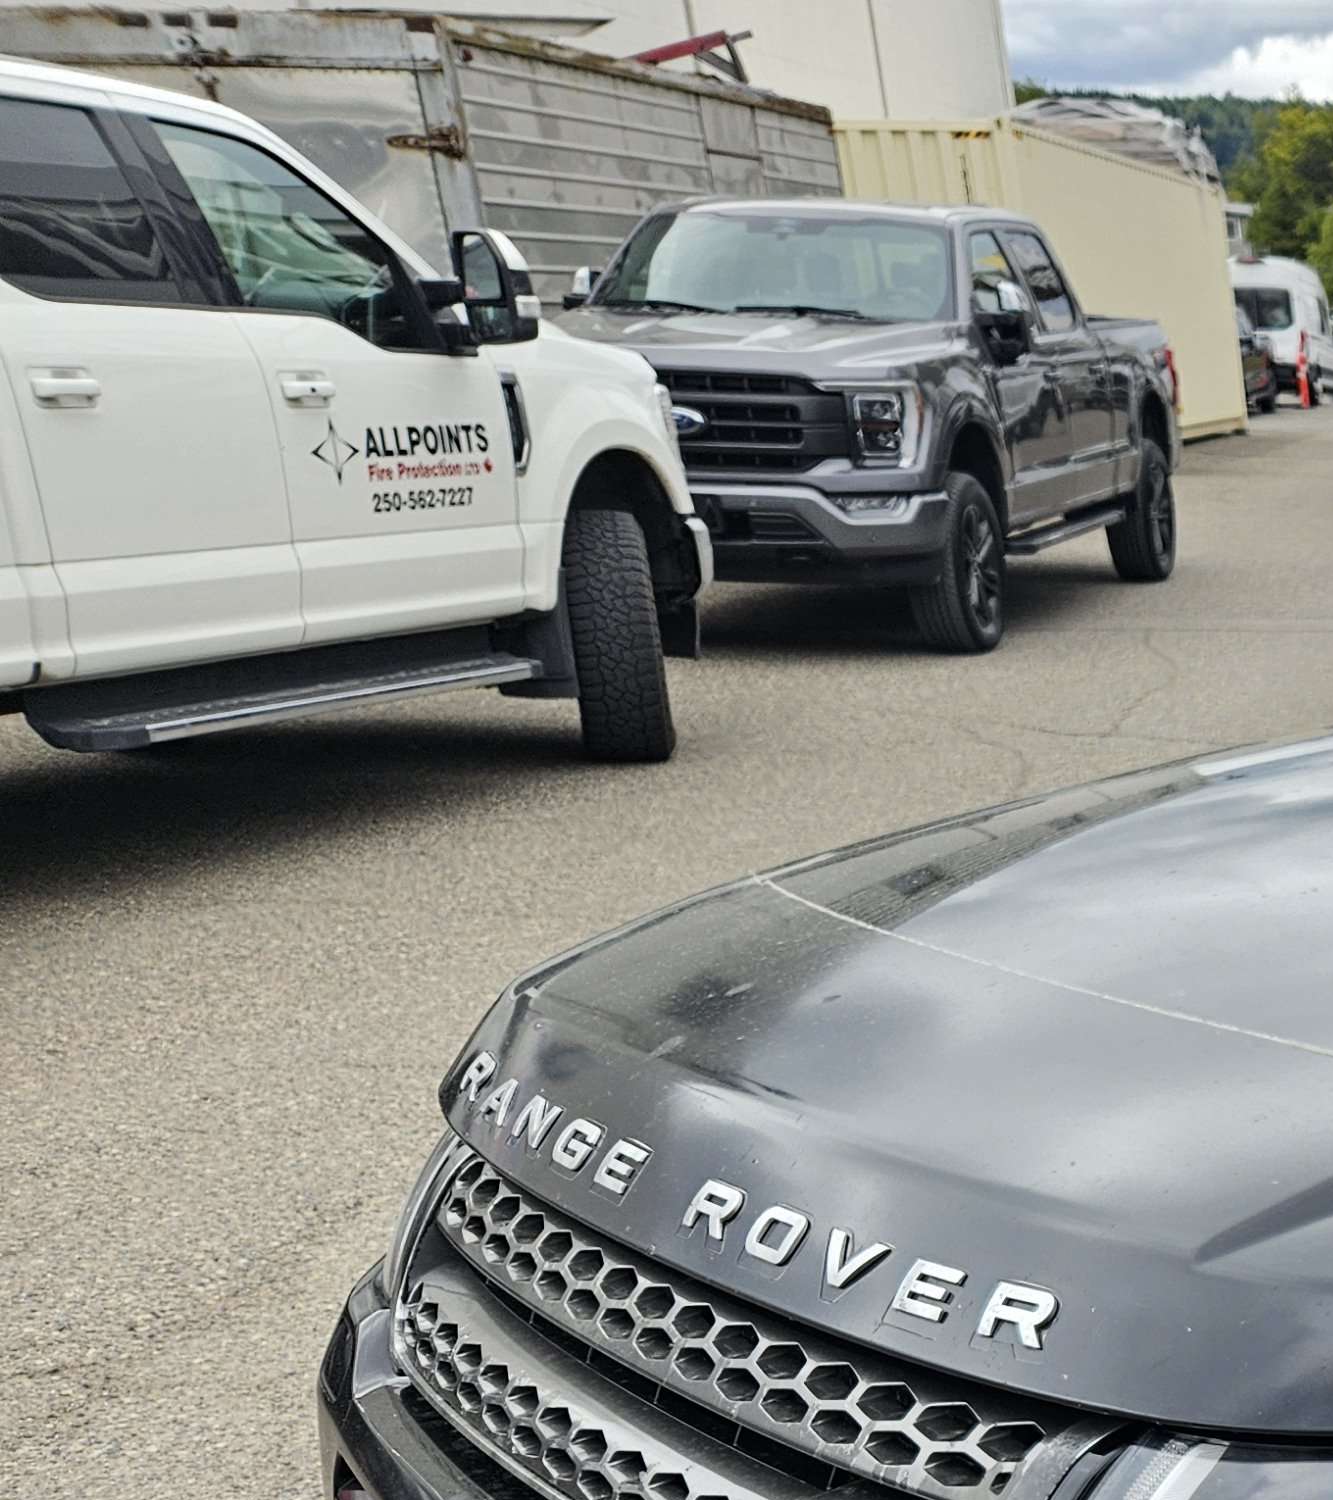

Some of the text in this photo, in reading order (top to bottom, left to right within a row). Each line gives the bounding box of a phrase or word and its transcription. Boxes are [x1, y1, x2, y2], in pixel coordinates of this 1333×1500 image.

[365, 424, 489, 458] ALLPOINTS
[368, 462, 393, 482] Fire
[397, 459, 462, 480] Protection
[372, 487, 473, 513] 250-562-7227
[460, 1050, 1058, 1350] RANGE ROVER
